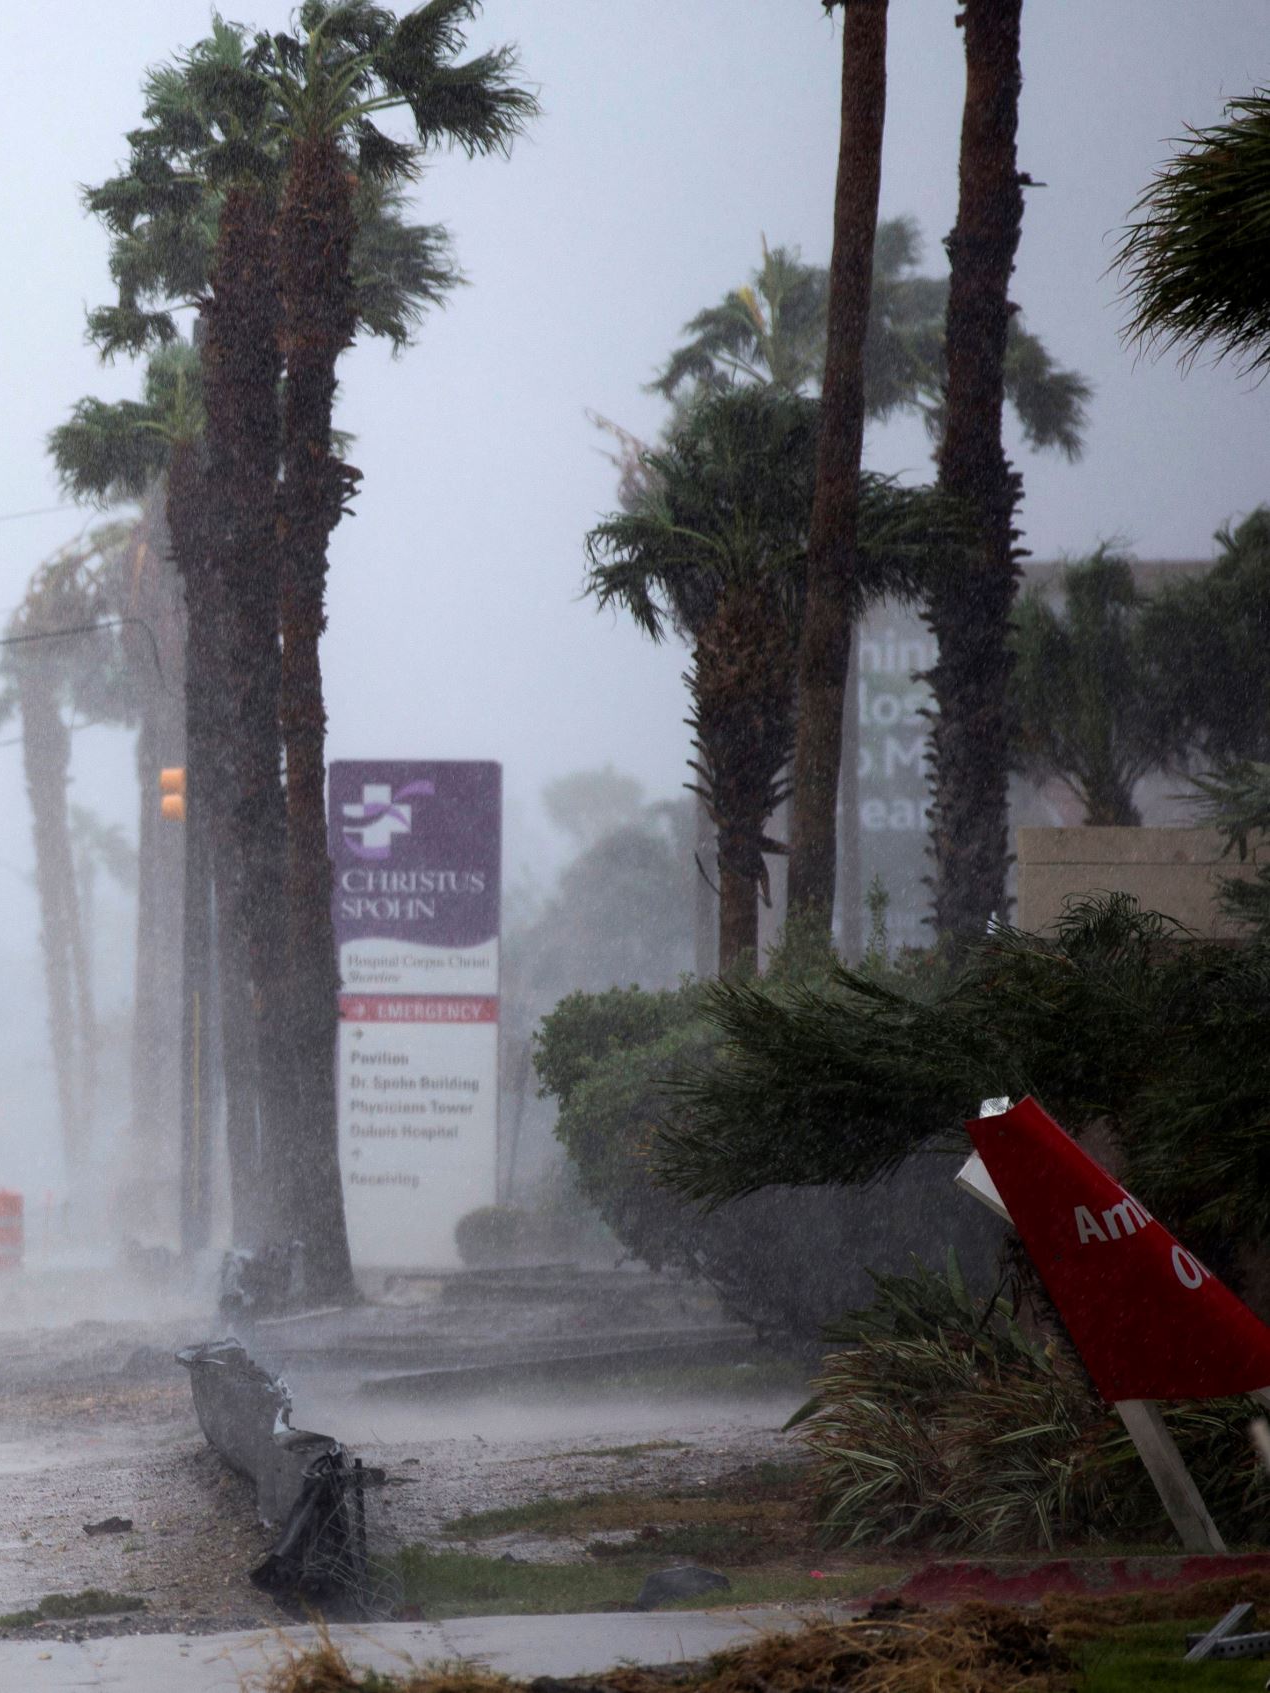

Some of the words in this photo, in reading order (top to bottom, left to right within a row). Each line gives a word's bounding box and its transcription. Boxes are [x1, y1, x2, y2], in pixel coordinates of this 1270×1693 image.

[341, 869, 485, 893] CHRISTUS
[341, 898, 435, 920] SPOHN
[348, 953, 399, 970] Hospital
[403, 953, 445, 972] Corpus
[449, 953, 490, 969] Christi
[377, 1002, 483, 1019] EMERGENCY
[351, 1051, 409, 1065] Pavilion
[351, 1075, 370, 1090] Dr.
[374, 1076, 417, 1093] Spohn
[420, 1075, 479, 1093] Building
[350, 1099, 426, 1117] Physicians
[431, 1100, 474, 1114] Tower
[402, 1123, 459, 1142] Hospital
